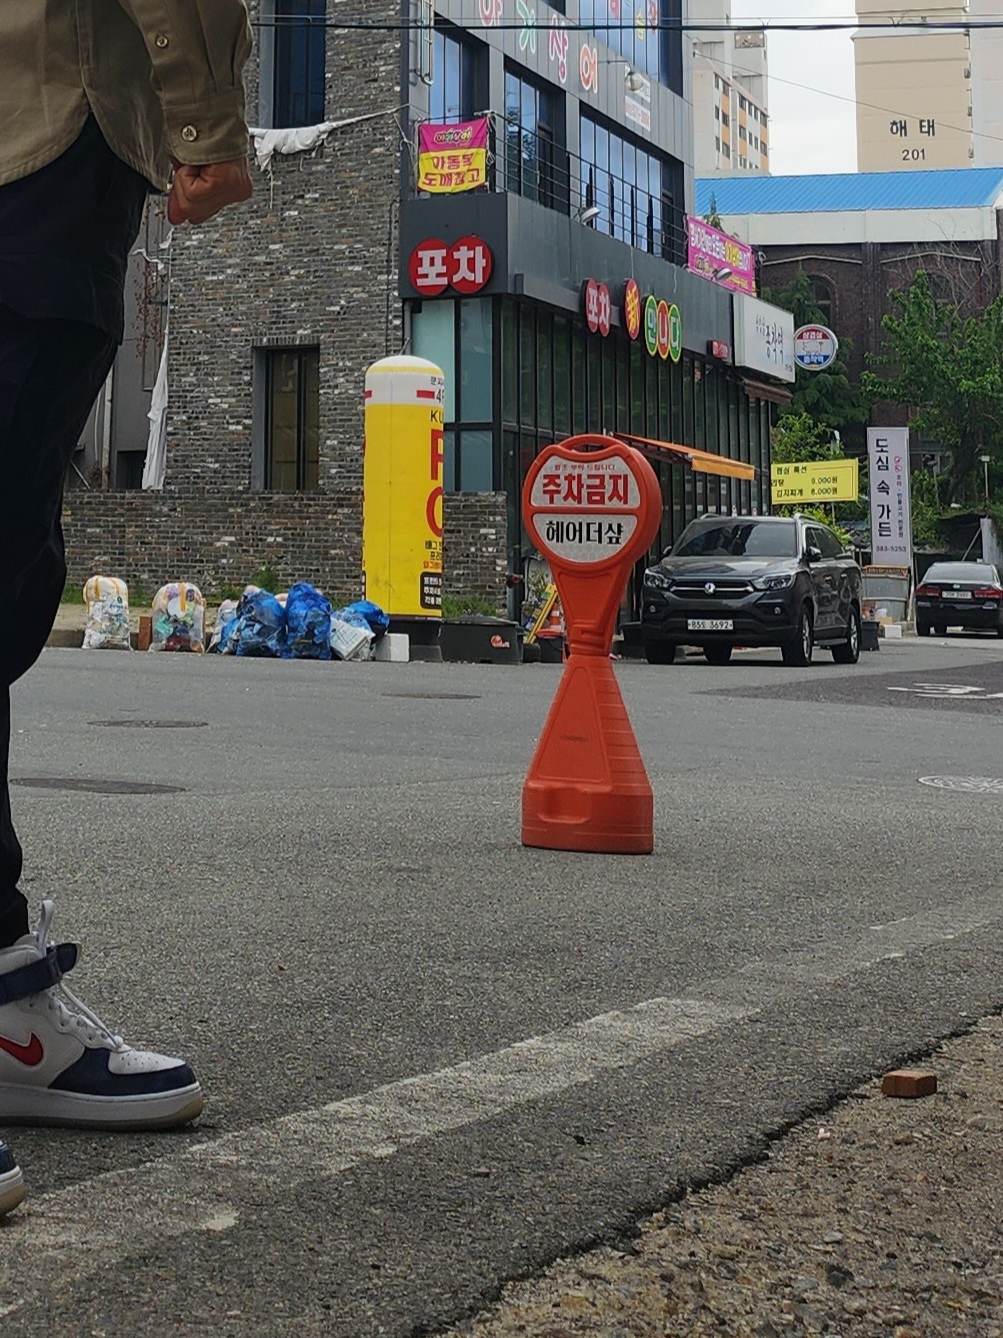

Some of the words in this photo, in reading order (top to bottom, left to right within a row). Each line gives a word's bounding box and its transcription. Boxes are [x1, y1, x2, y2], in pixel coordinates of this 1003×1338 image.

[902, 148, 926, 161] 201
[416, 245, 487, 286] 포차
[587, 287, 609, 330] 포차
[876, 438, 890, 471] 도심
[542, 473, 629, 505] 주차금지
[876, 480, 891, 496] 속
[877, 504, 892, 537] 가든
[710, 620, 729, 629] 3692
